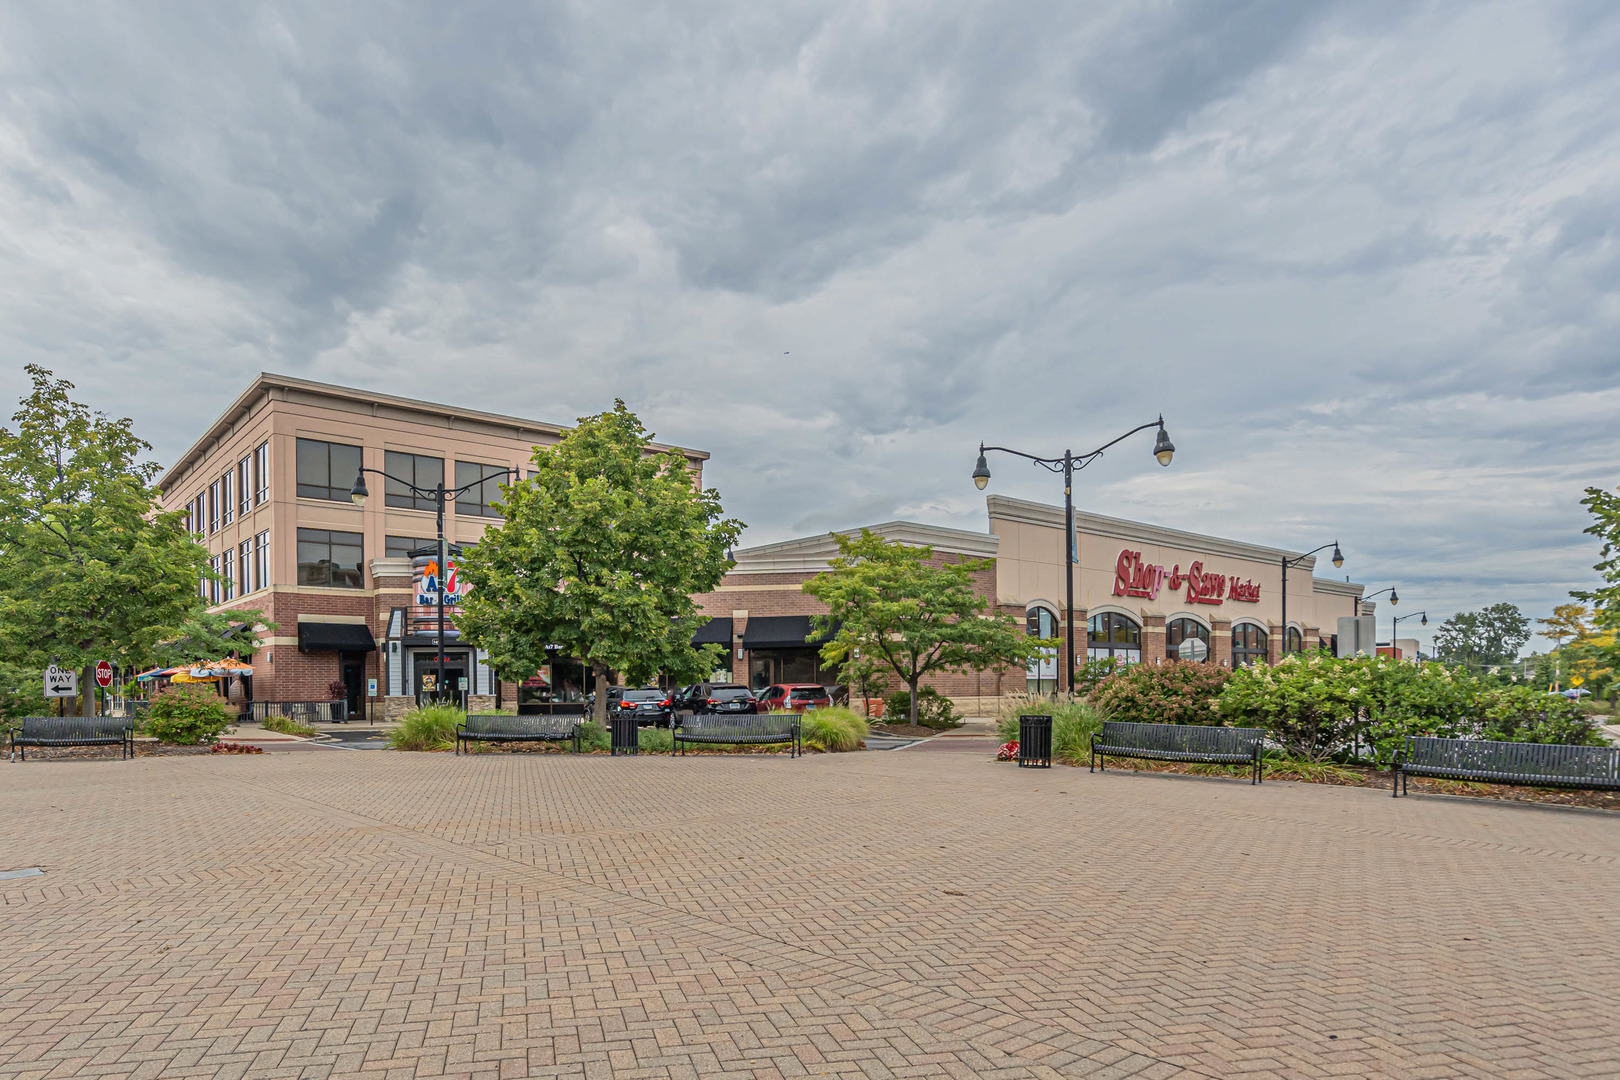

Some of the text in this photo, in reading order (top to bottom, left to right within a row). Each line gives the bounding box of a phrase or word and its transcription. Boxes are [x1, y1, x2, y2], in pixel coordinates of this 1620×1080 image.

[419, 594, 462, 605] Bar Gril
[49, 675, 72, 683] WAY
[97, 668, 111, 679] STOP
